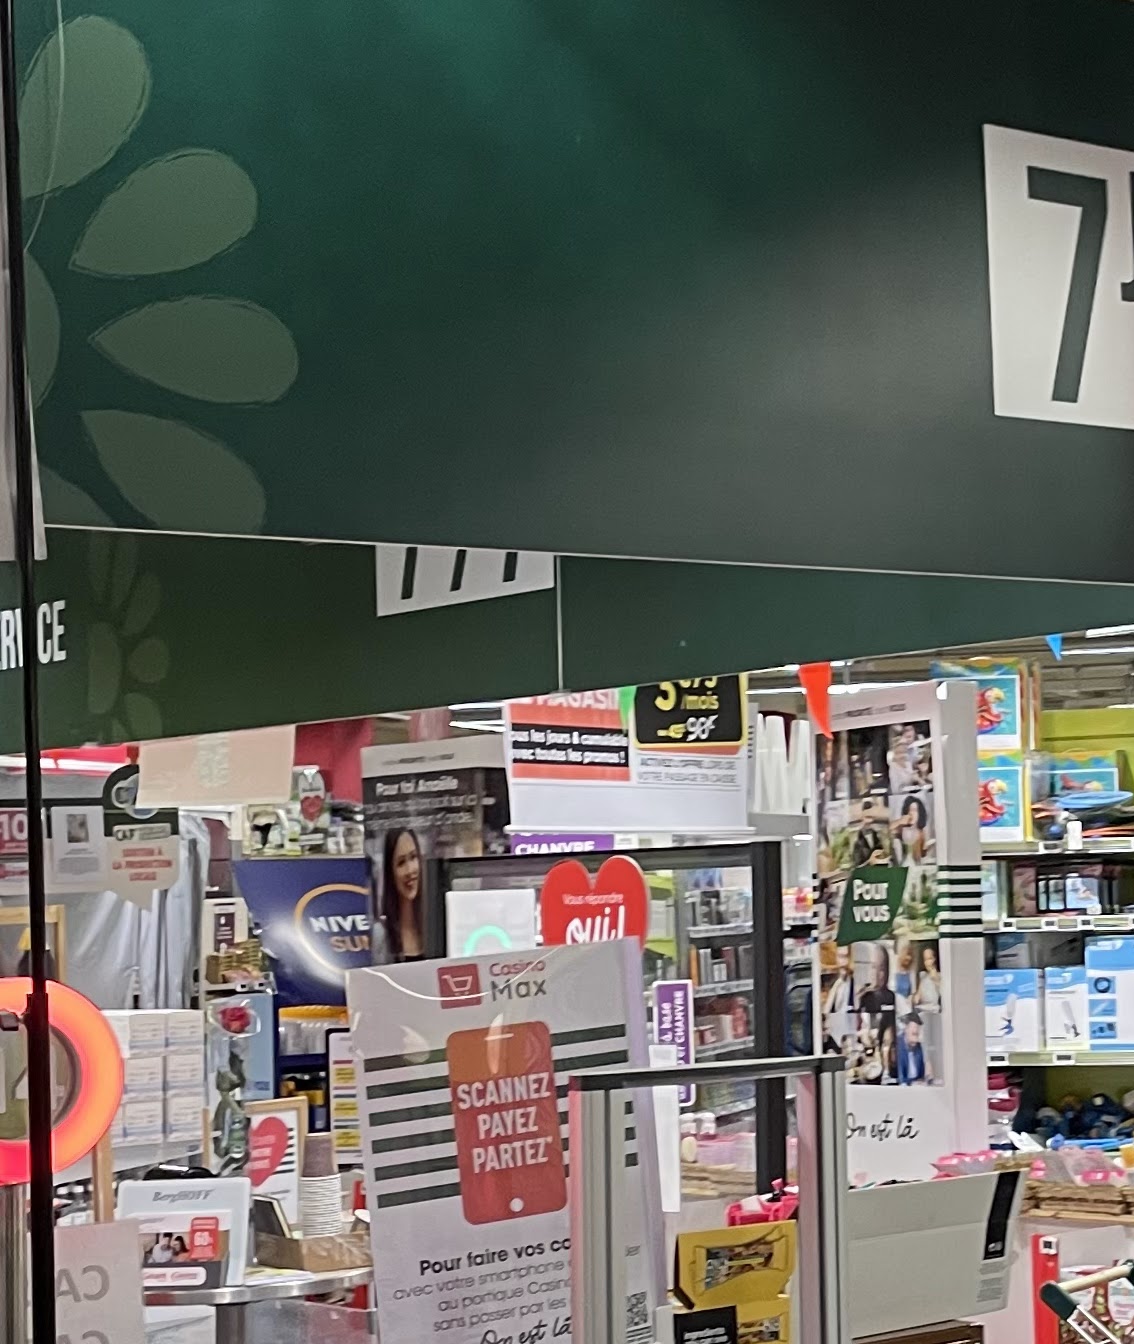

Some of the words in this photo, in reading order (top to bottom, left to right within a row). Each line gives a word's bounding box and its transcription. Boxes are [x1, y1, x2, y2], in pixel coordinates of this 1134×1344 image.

[853, 879, 889, 901] Pour
[309, 914, 370, 932] NIVE
[852, 904, 891, 923] vous
[489, 959, 546, 978] Casino
[490, 979, 547, 1002] Max
[456, 1071, 551, 1111] SCANNEZ
[476, 1106, 539, 1141] PAYEZ
[420, 1256, 461, 1276] Pour
[466, 1248, 508, 1268] faire
[513, 1242, 545, 1258] vos
[393, 1285, 433, 1301] avec
[436, 1273, 475, 1291] votre
[478, 1261, 565, 1287] smartphone
[438, 1296, 460, 1312] au
[462, 1287, 524, 1309] portique
[433, 1317, 466, 1333] sans
[469, 1305, 517, 1328] passer
[519, 1300, 545, 1319] par
[548, 1296, 567, 1311] les
